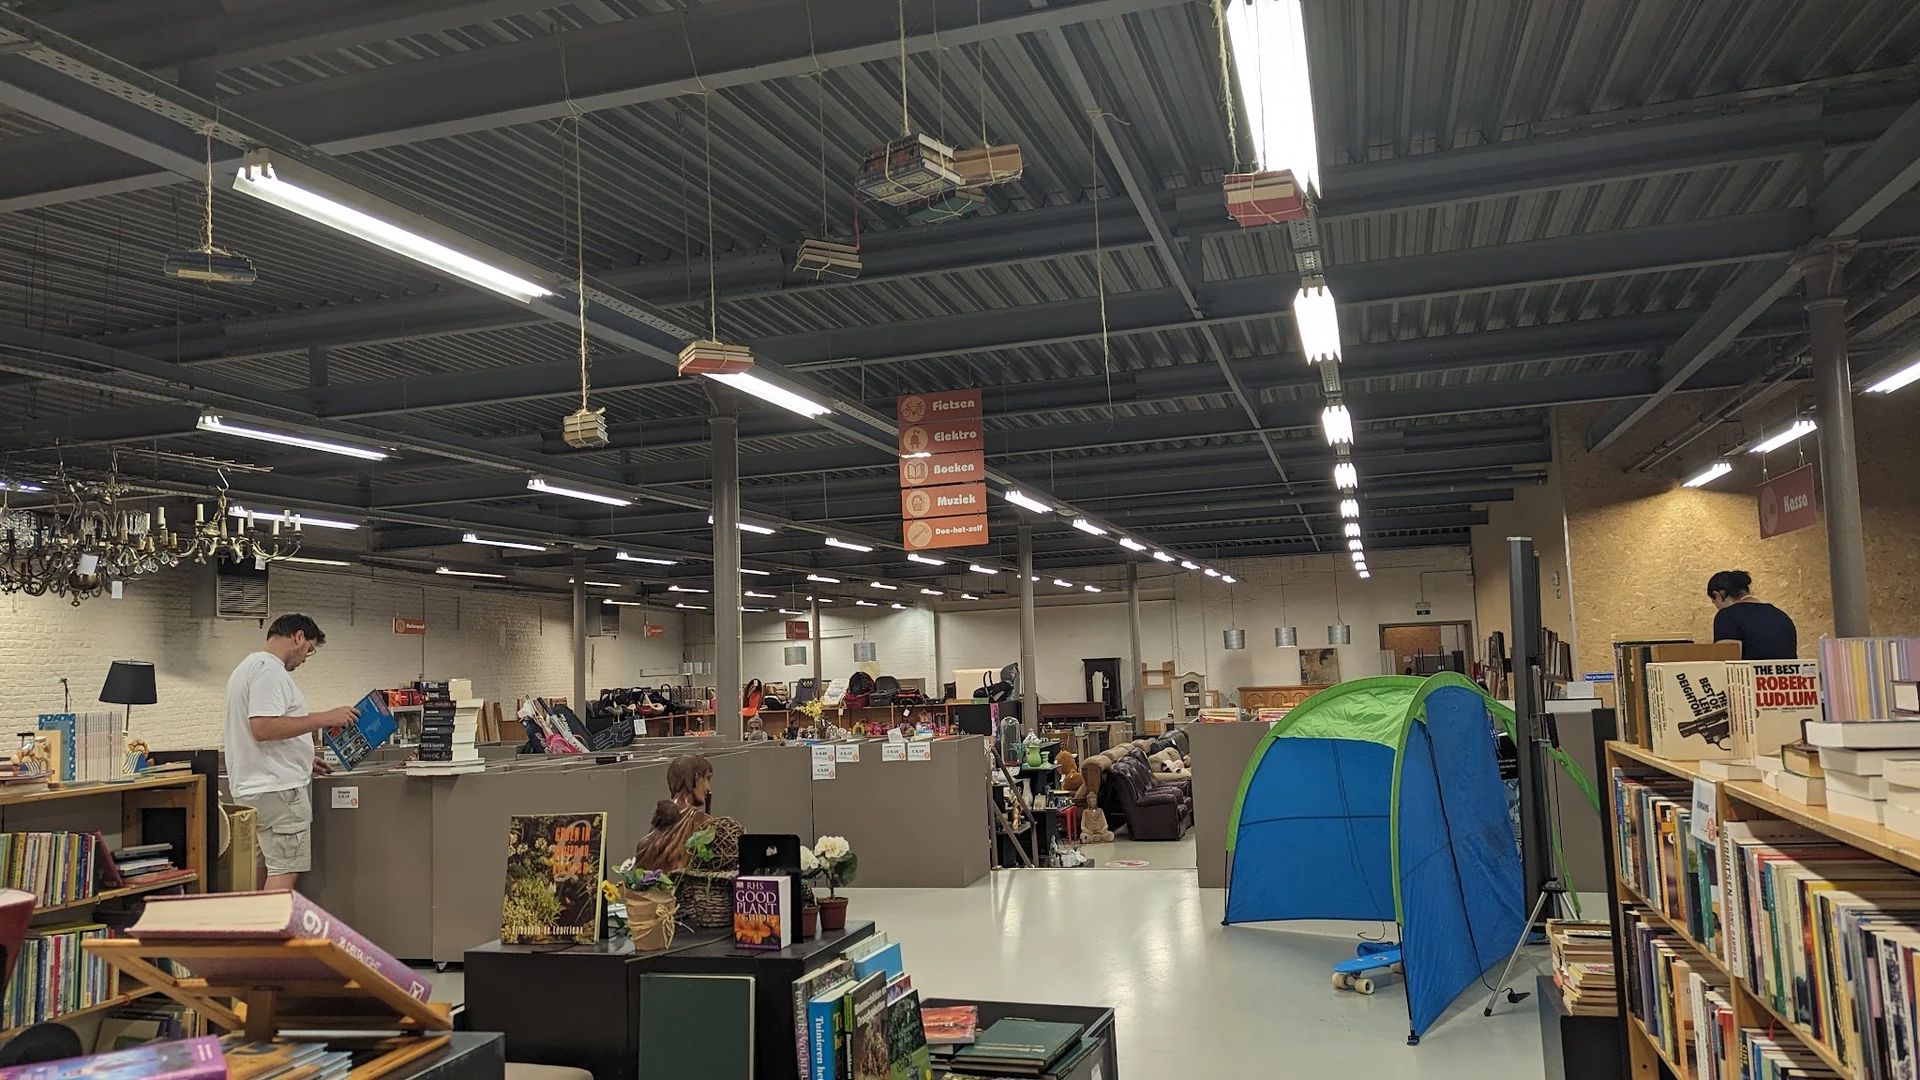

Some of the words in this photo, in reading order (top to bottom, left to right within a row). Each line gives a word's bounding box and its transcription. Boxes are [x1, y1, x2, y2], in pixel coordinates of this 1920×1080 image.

[932, 399, 975, 411] Fietsen
[934, 430, 977, 442] Elektro
[933, 463, 975, 475] Boeken
[937, 494, 976, 507] Muziek
[1783, 493, 1808, 513] Kassa
[935, 525, 983, 535] Doe-het-zelf
[1753, 665, 1773, 675] THE
[1775, 664, 1800, 675] BEST
[1755, 675, 1816, 691] ROBERT
[1676, 672, 1703, 717] DEIGHTON
[1698, 677, 1716, 698] BEST
[1709, 698, 1721, 710] OF
[1716, 690, 1728, 709] THE
[1755, 691, 1818, 707] LUDLUM
[1698, 697, 1712, 714] LEN
[1723, 832, 1733, 897] GERRITSEN
[746, 882, 764, 890] RHS
[736, 890, 777, 904] GOOD
[736, 902, 777, 915] PLANT
[742, 913, 770, 923] GUIDE
[796, 1008, 806, 1034] TUIN
[798, 1035, 807, 1056] VOL
[815, 1016, 825, 1064] Tuinieren
